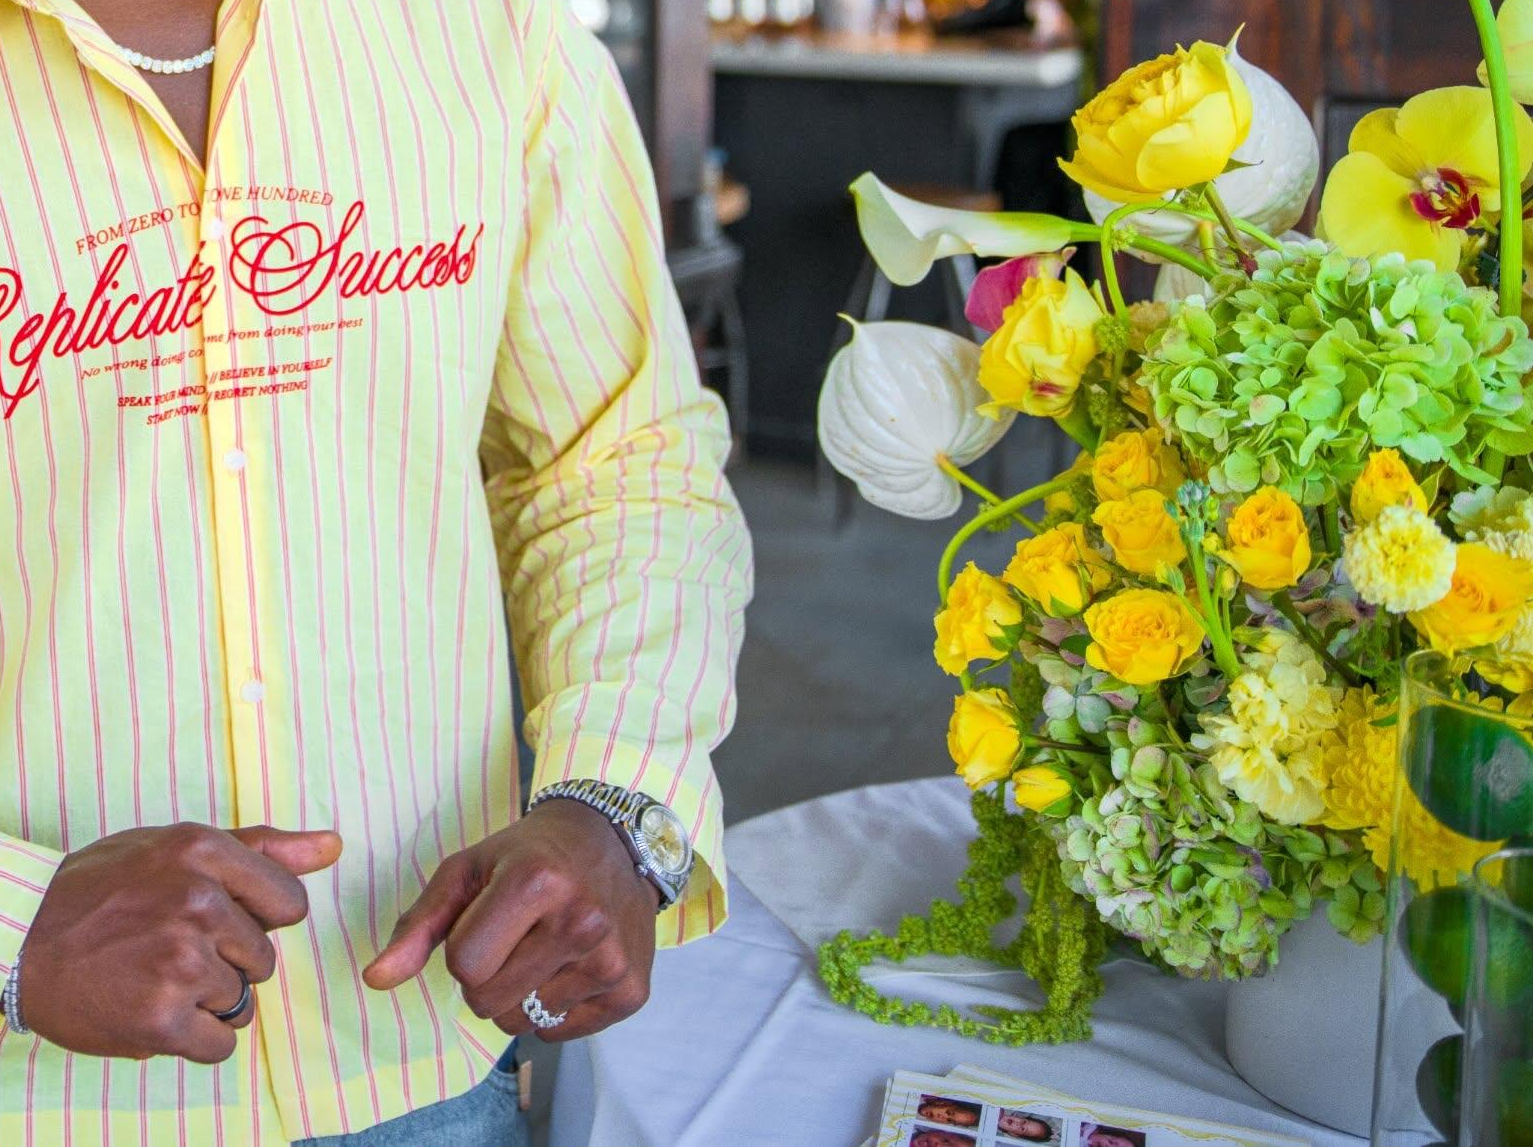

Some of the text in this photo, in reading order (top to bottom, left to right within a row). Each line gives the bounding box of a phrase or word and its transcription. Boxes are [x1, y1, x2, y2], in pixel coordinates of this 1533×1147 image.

[75, 185, 334, 255] FROM ZERO TO ONE HUNDRED
[230, 200, 484, 316] Success
[81, 368, 100, 379] No
[104, 358, 148, 370] wrong
[151, 352, 185, 367] doing
[226, 330, 260, 344] from
[264, 325, 304, 339] doing
[338, 318, 364, 329] best
[117, 396, 152, 407] SPEAK
[154, 390, 176, 405] YOUR
[177, 385, 207, 399] MIND
[219, 365, 266, 381] BELIEVE
[267, 365, 279, 375] IN
[281, 357, 333, 373] YOURSELF
[146, 409, 174, 425] START
[175, 404, 200, 416] NOW
[214, 385, 256, 401] REGRET
[258, 380, 308, 396] NOTHING
